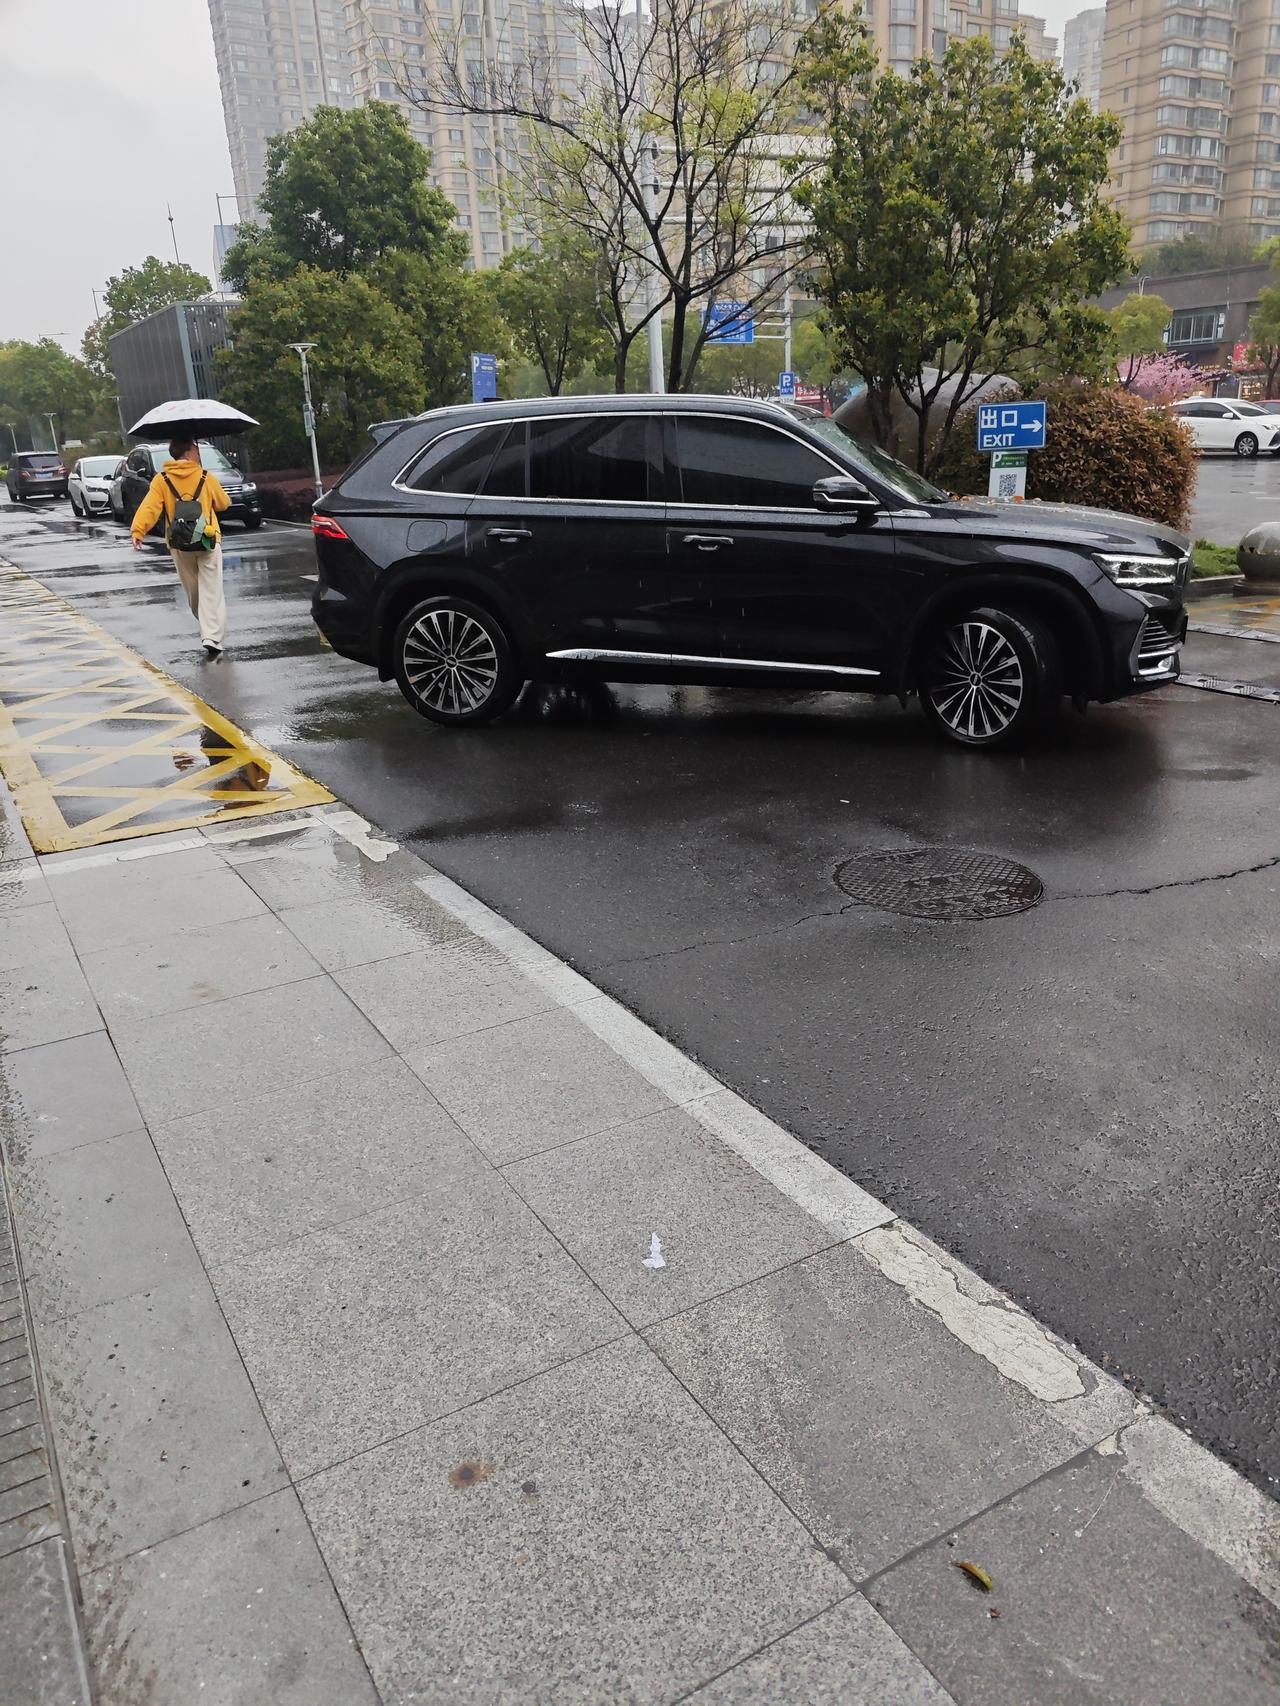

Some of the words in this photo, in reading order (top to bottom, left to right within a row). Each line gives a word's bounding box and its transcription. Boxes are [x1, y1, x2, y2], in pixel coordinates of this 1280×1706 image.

[473, 356, 480, 373] P
[782, 375, 791, 387] P
[981, 409, 1018, 428] 出口
[983, 433, 1015, 447] EXIT
[992, 451, 1002, 468] P
